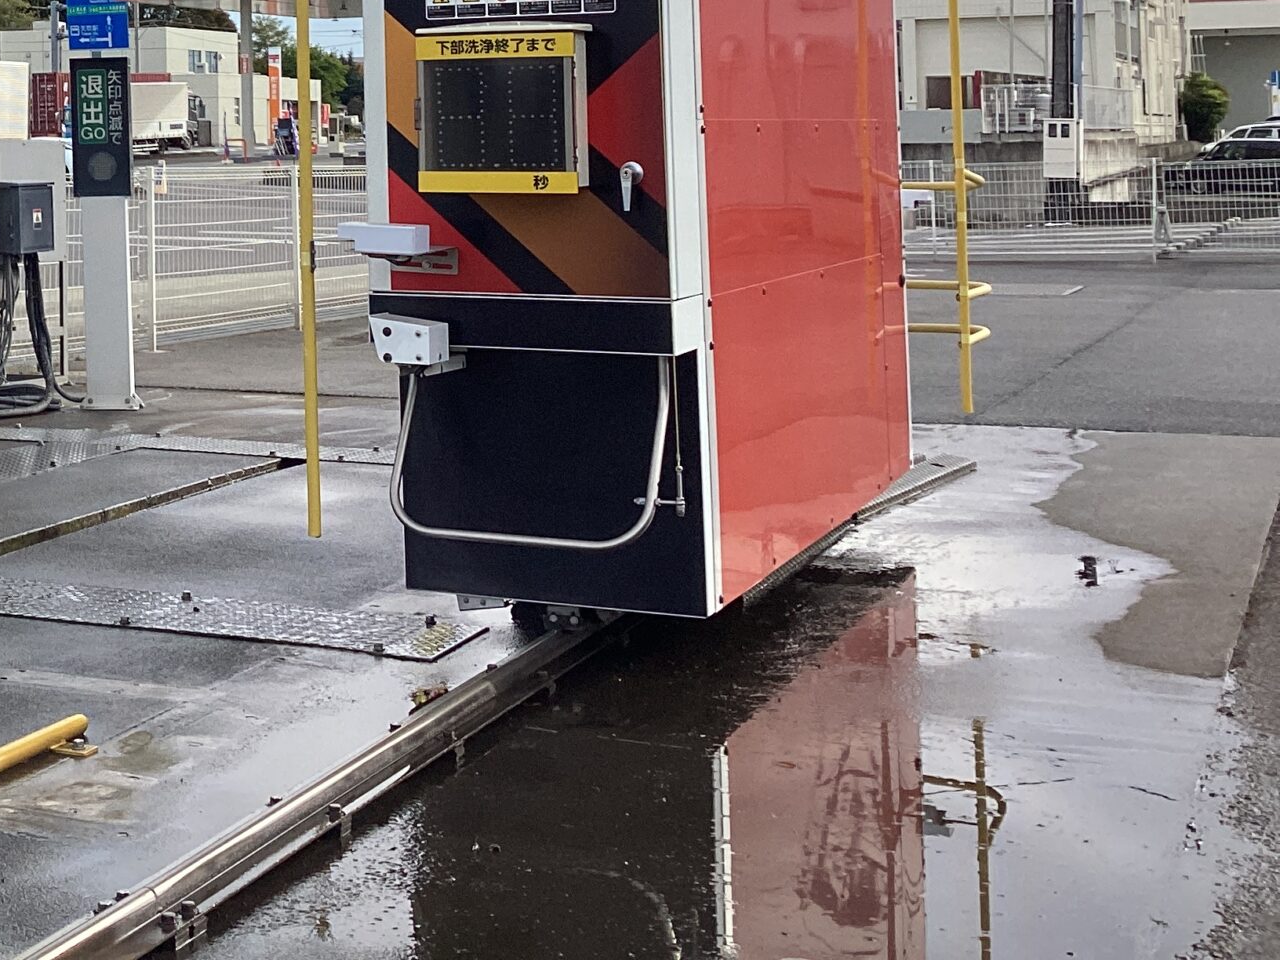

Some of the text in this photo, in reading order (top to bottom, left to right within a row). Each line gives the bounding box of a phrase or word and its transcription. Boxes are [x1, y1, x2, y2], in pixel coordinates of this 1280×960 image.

[436, 37, 556, 55] 下部洗浄終了まで
[80, 75, 104, 125] 退出
[107, 69, 123, 145] 矢印点滅で
[80, 126, 106, 140] GO
[533, 174, 549, 191] 秒
